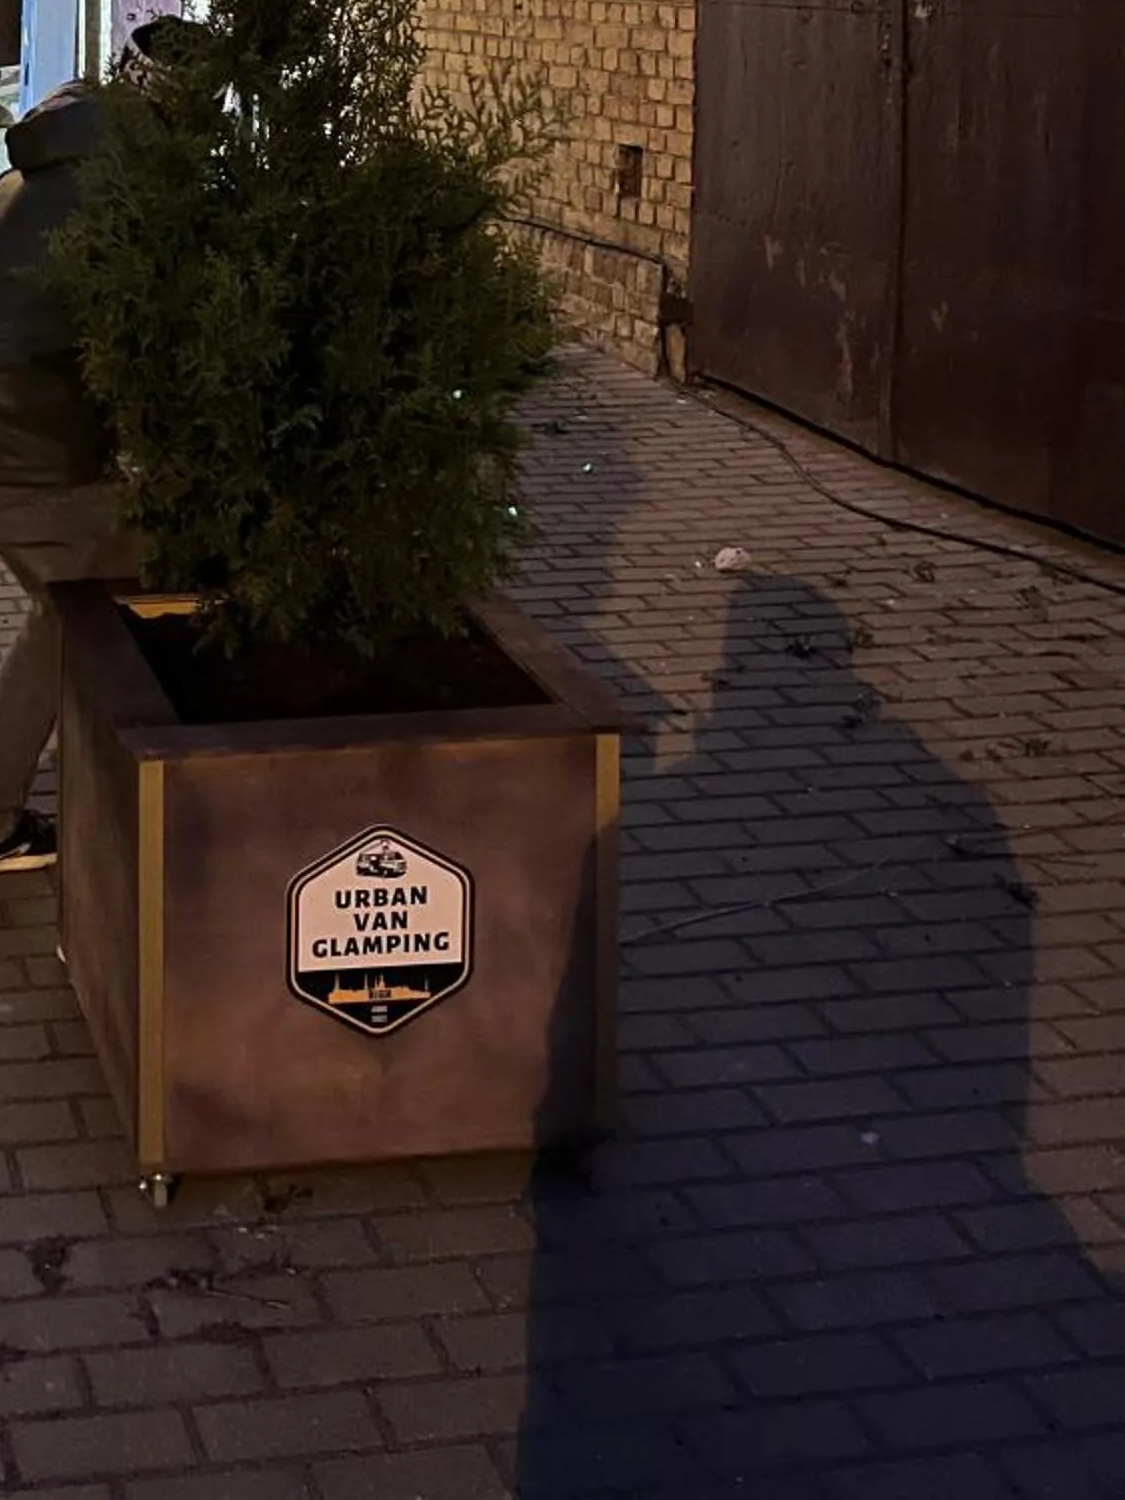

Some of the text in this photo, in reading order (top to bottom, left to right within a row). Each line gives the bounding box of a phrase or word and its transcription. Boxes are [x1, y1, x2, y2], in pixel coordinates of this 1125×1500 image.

[336, 886, 427, 908] URBAN
[354, 911, 408, 931] VAN
[312, 932, 450, 958] GLAMPING
